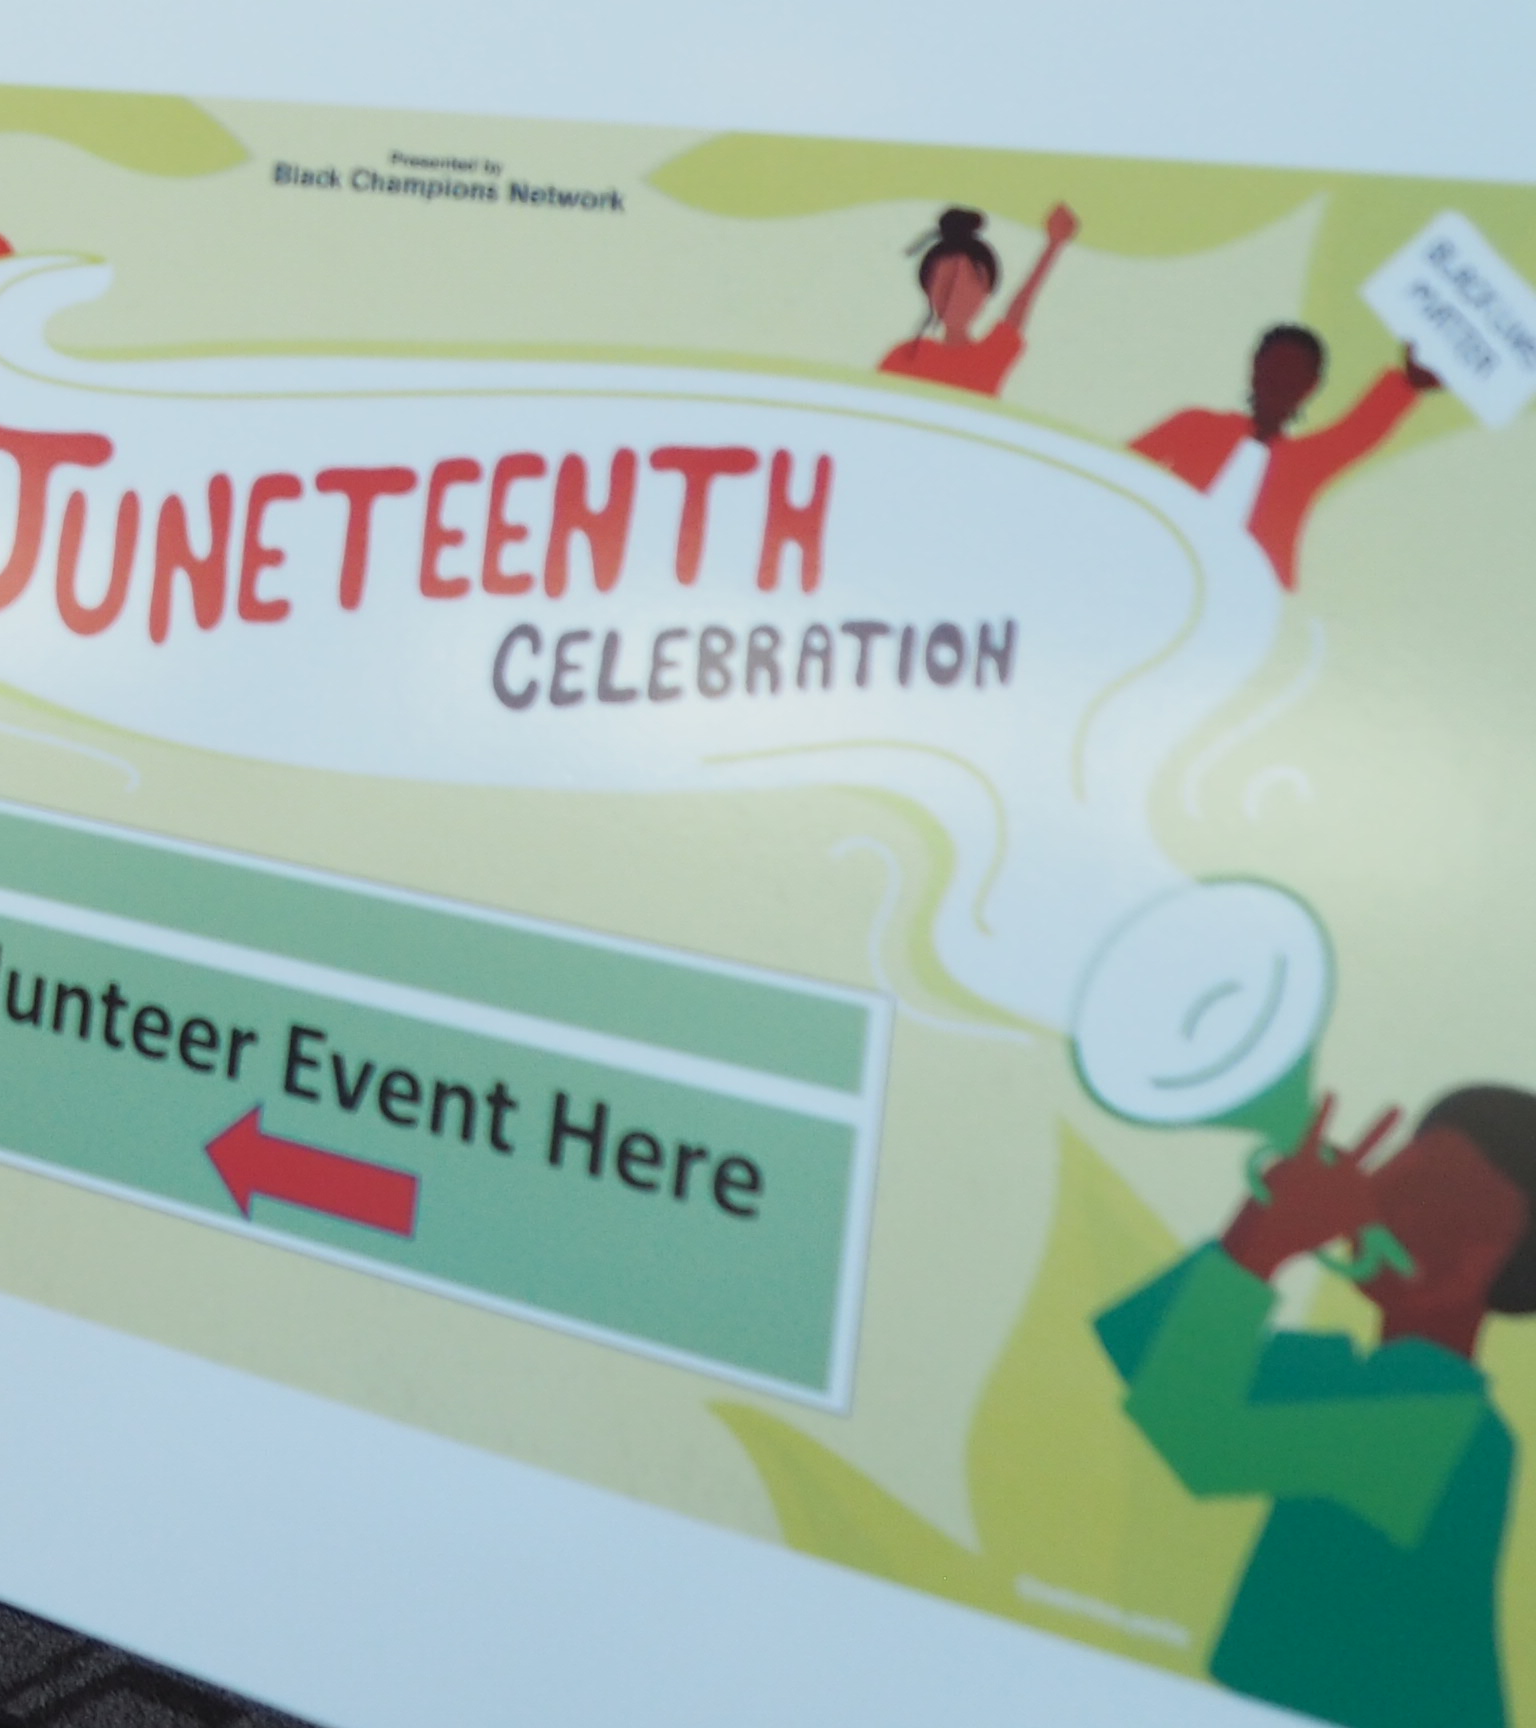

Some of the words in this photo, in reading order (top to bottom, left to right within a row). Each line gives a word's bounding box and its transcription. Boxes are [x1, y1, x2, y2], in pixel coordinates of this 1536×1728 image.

[274, 161, 342, 188] Black
[352, 168, 499, 201] Champions
[510, 180, 625, 212] Network
[391, 150, 478, 173] Presented
[484, 159, 504, 177] by
[490, 618, 1016, 710] CELEBRATION
[282, 1024, 519, 1154] Event
[546, 1092, 764, 1218] Here
